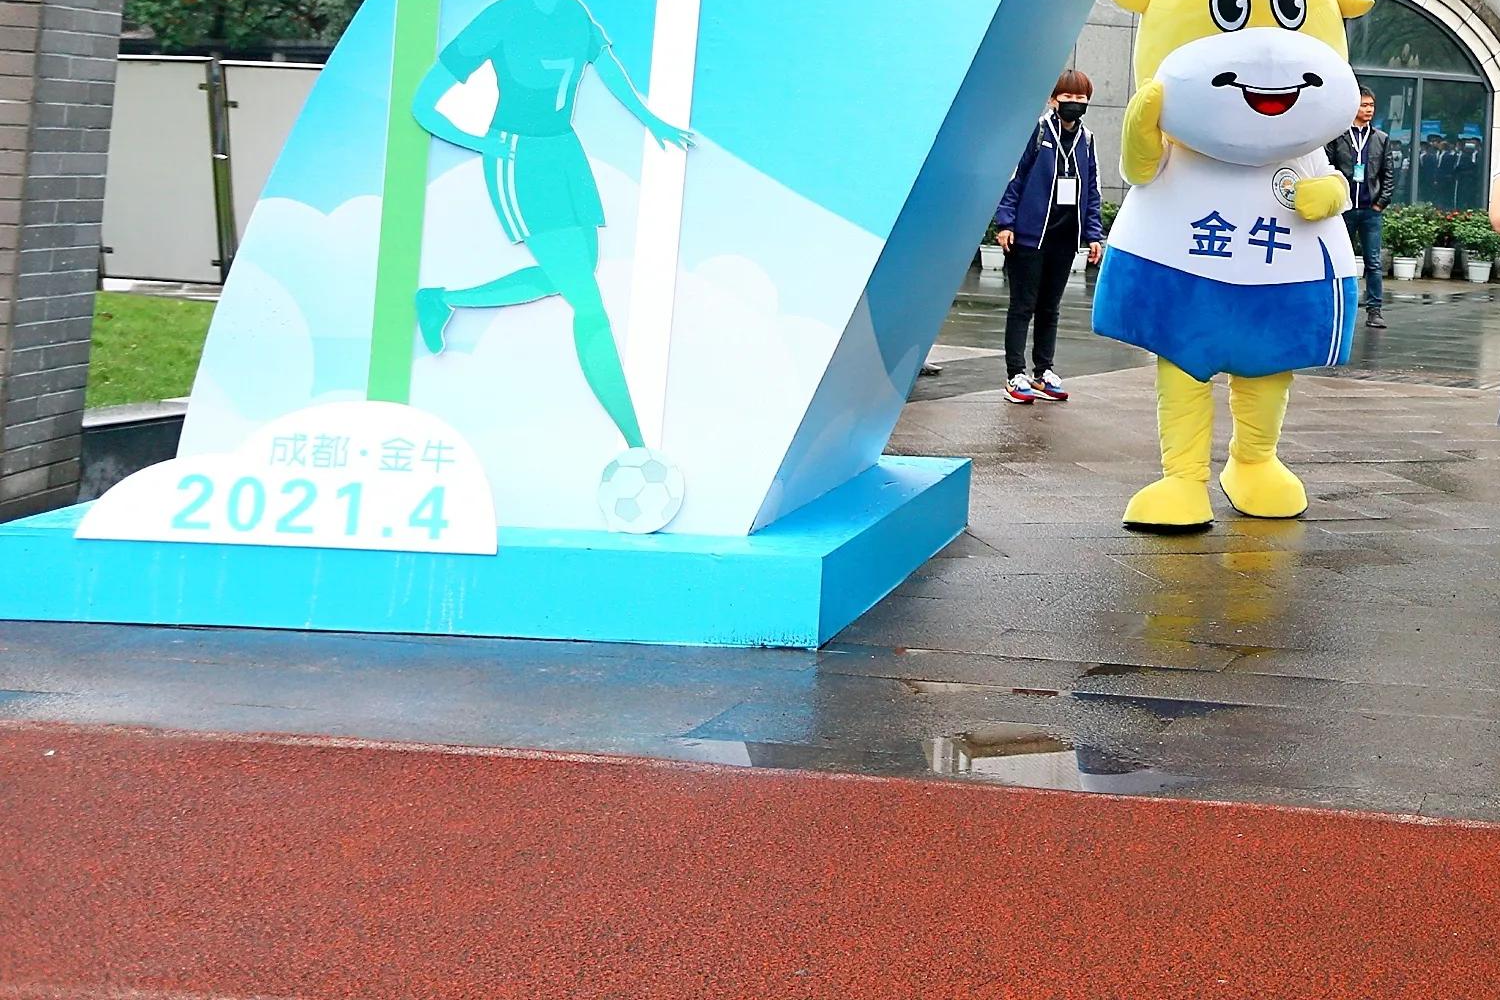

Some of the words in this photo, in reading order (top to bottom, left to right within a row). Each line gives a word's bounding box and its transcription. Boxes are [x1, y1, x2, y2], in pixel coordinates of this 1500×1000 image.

[541, 57, 577, 112] 7
[1188, 210, 1292, 265] 金牛
[270, 433, 456, 474] 成都·金牛
[172, 474, 449, 540] 2021.4
